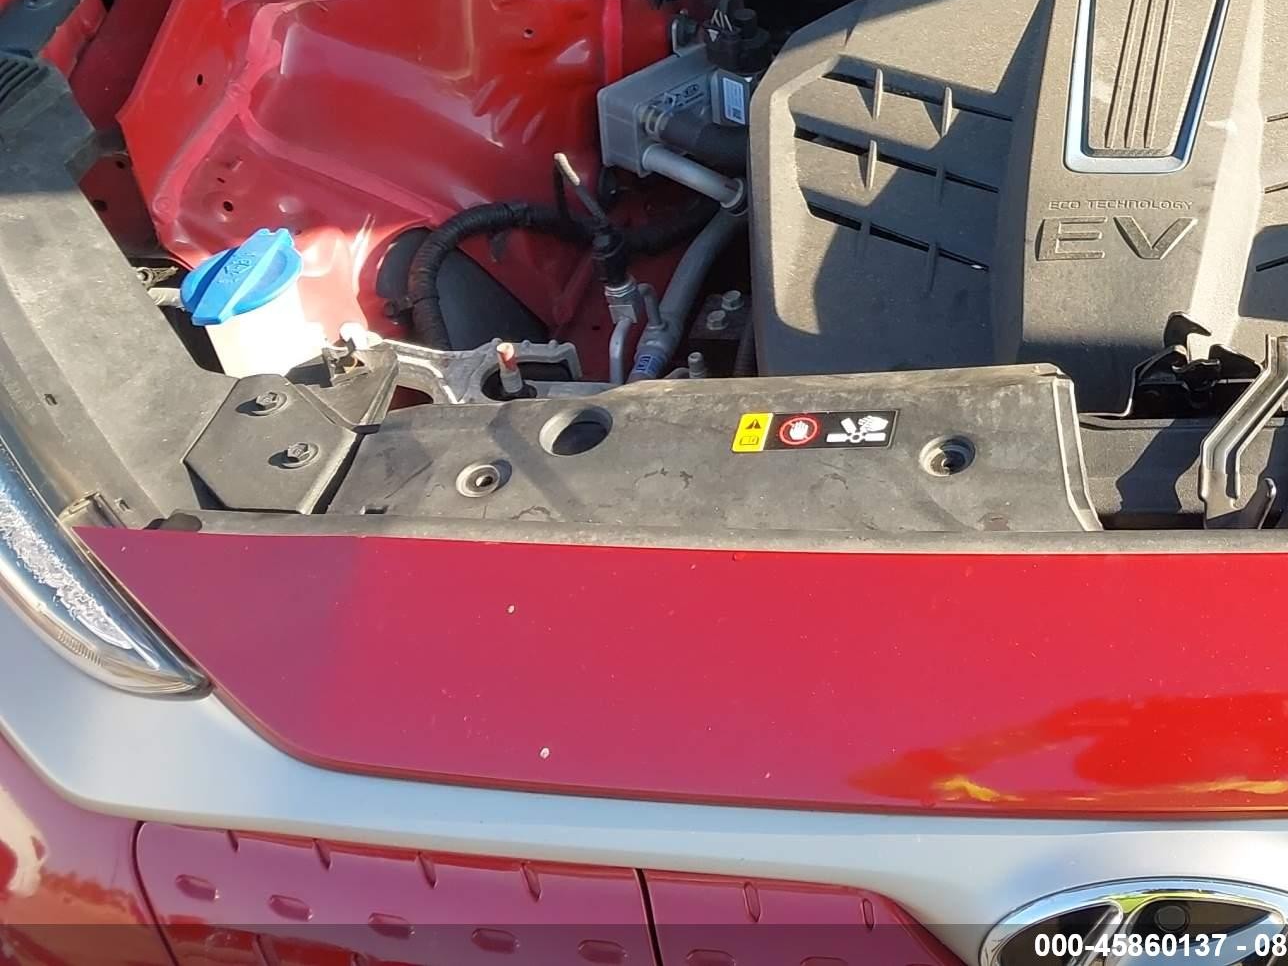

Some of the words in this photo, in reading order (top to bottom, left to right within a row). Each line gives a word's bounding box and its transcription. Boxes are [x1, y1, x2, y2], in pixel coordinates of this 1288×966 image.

[1049, 200, 1081, 211] ECO
[1087, 199, 1193, 211] TECHNOLOGY
[1034, 215, 1199, 261] EV
